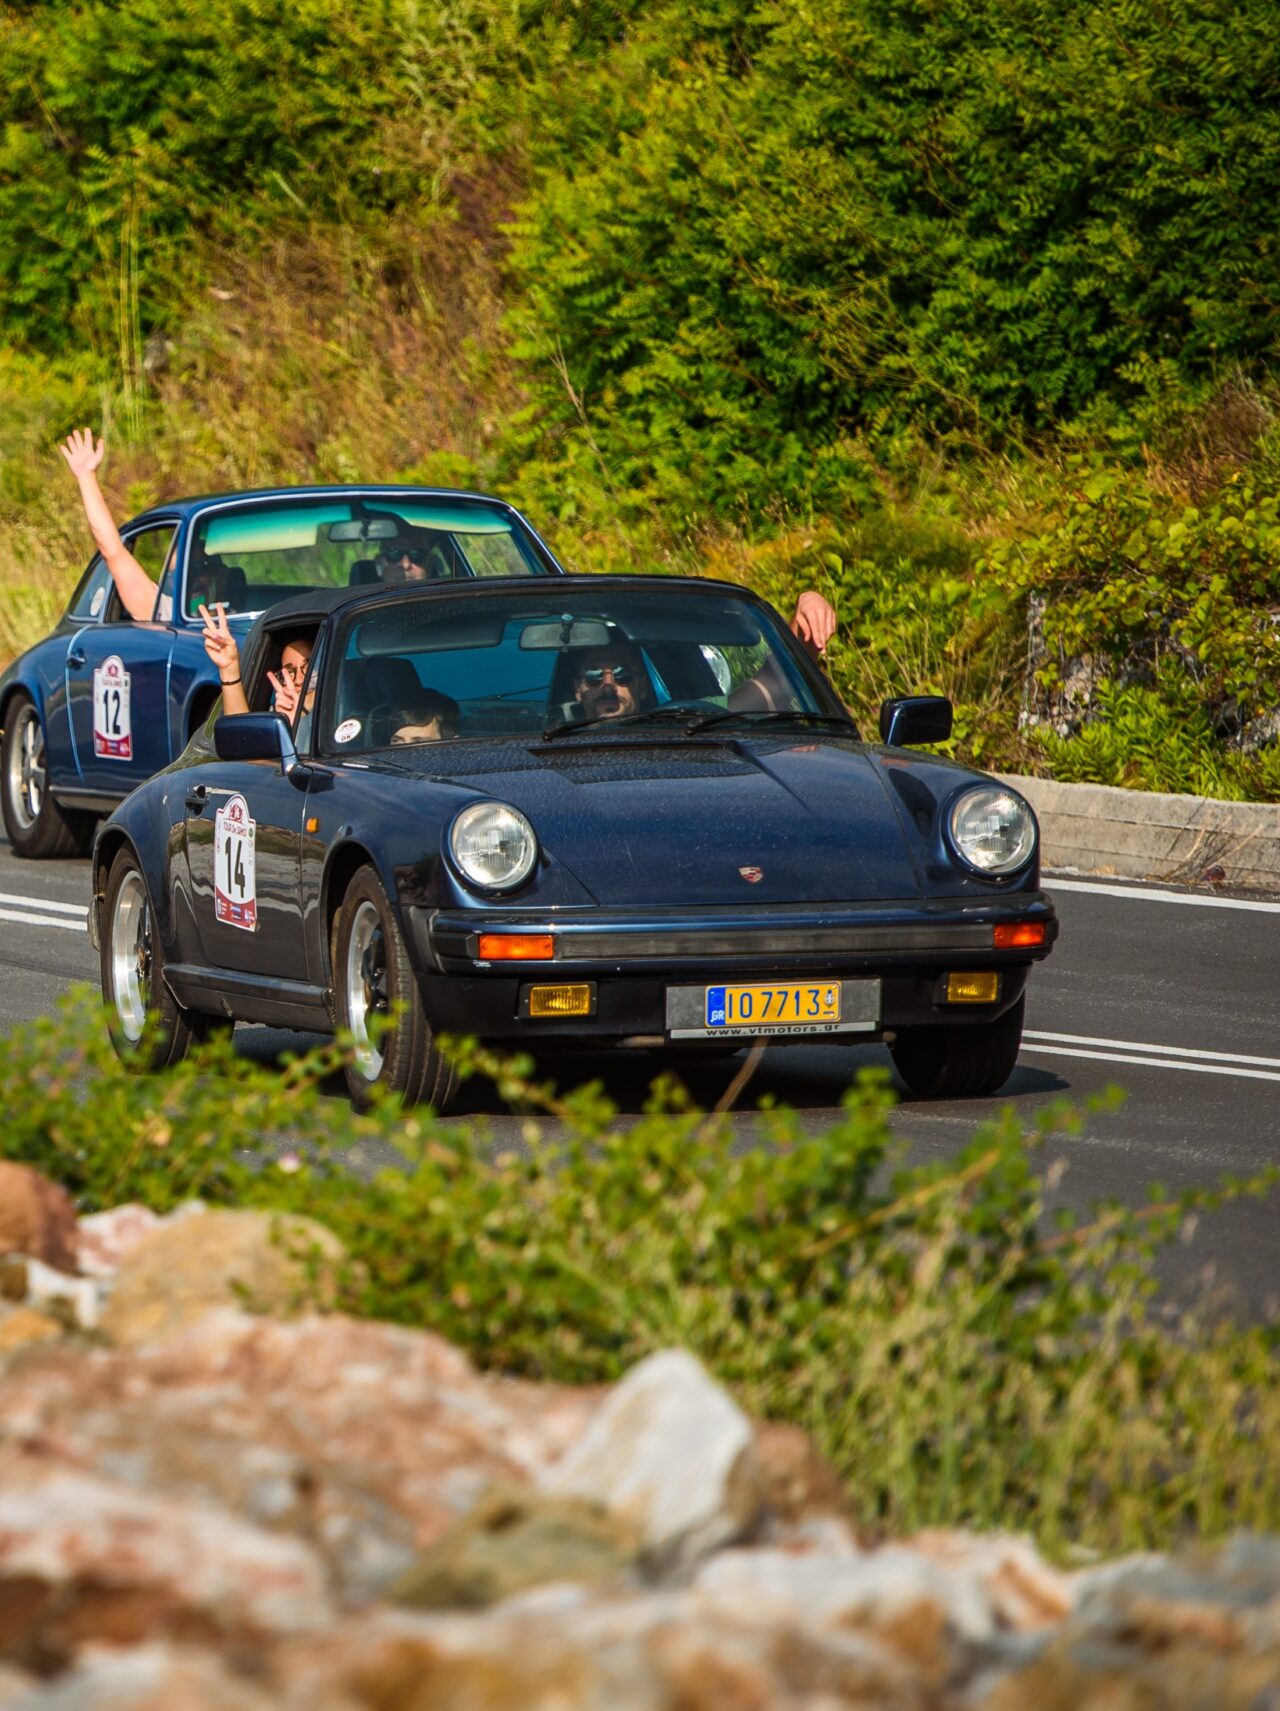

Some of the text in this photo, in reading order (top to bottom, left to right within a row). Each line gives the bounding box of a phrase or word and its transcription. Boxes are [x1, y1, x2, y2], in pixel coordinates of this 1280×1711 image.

[104, 689, 121, 735] 12
[225, 836, 246, 898] 14
[706, 1024, 840, 1036] www.vtmotors.gr
[711, 1010, 725, 1021] GR
